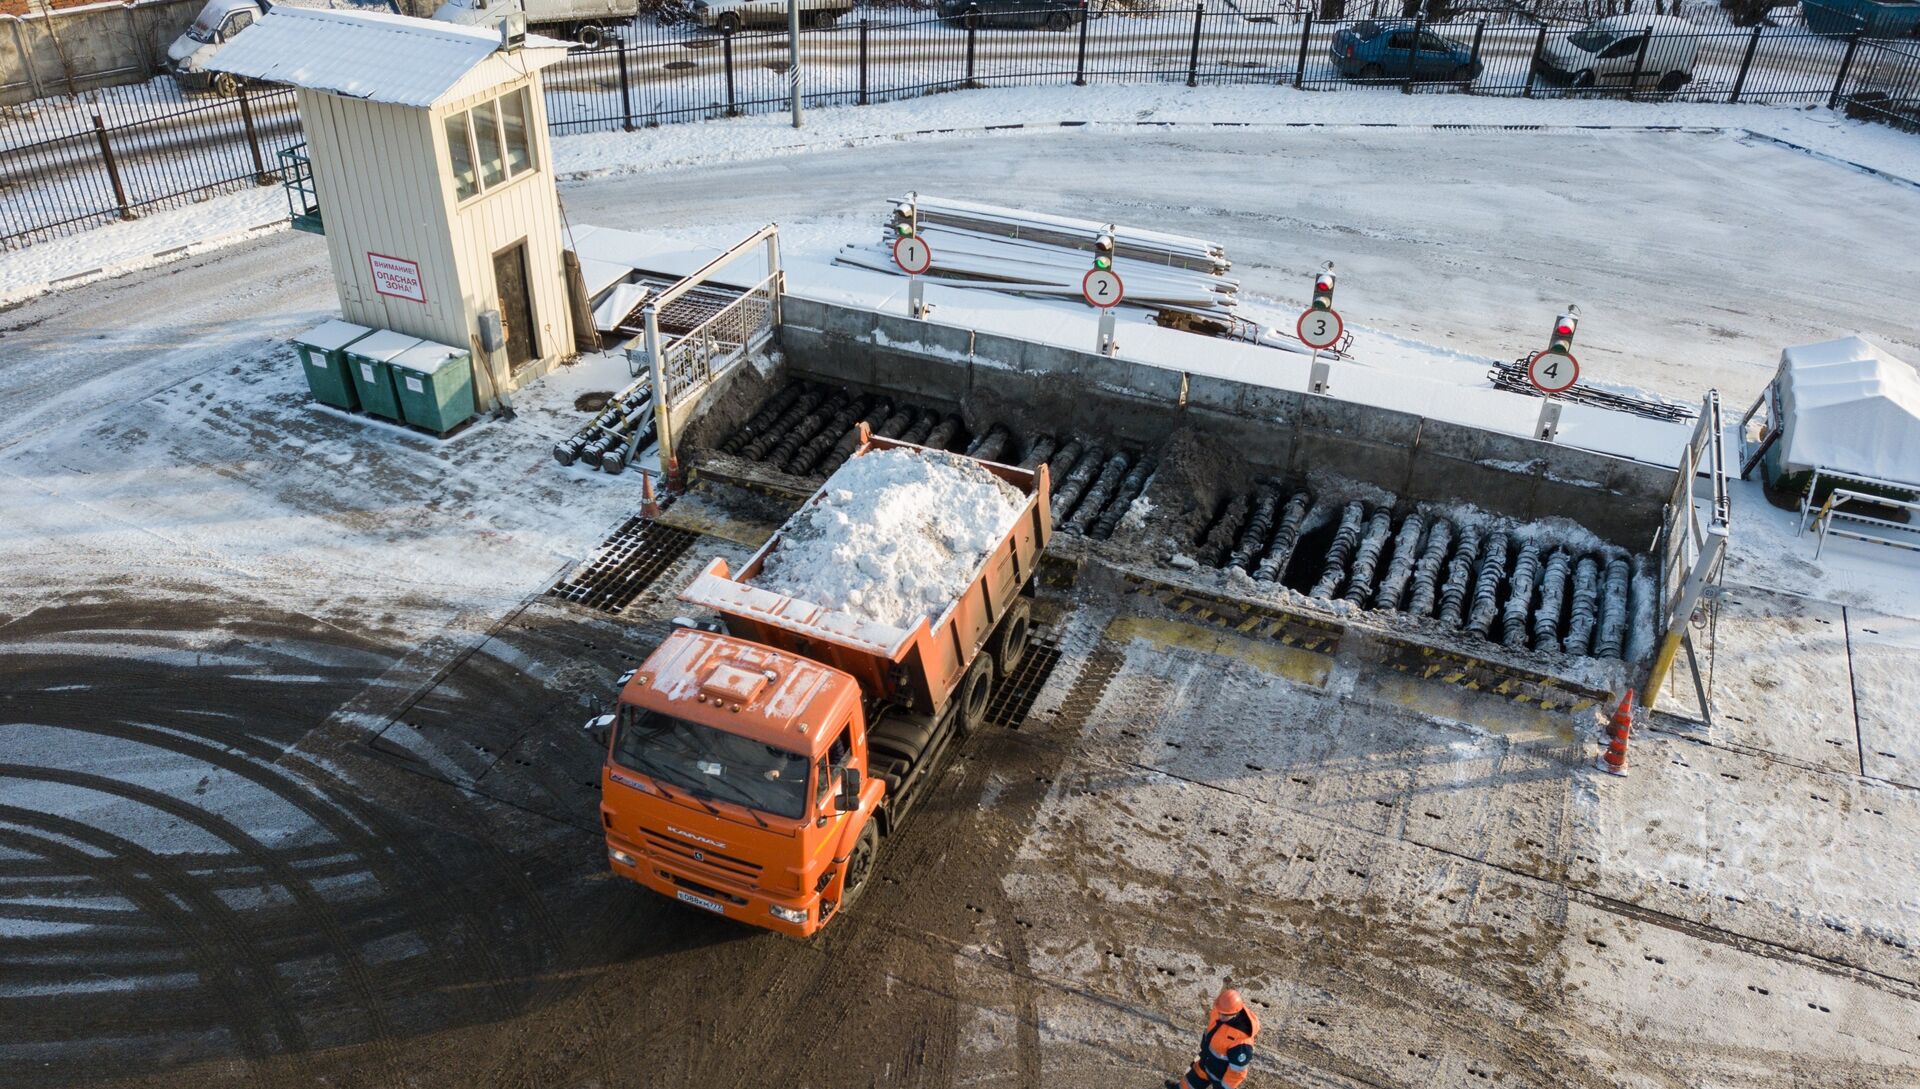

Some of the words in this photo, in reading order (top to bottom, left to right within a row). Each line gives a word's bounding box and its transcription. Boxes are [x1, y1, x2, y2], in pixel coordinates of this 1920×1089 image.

[908, 246, 915, 262] 1
[374, 260, 416, 275] ВНИМАНИЕ!
[376, 271, 418, 287] ОПАСНАЯ
[385, 280, 413, 294] ЗОНА!
[1097, 280, 1109, 296] 2
[1313, 319, 1327, 336] 3
[1543, 362, 1559, 379] 4
